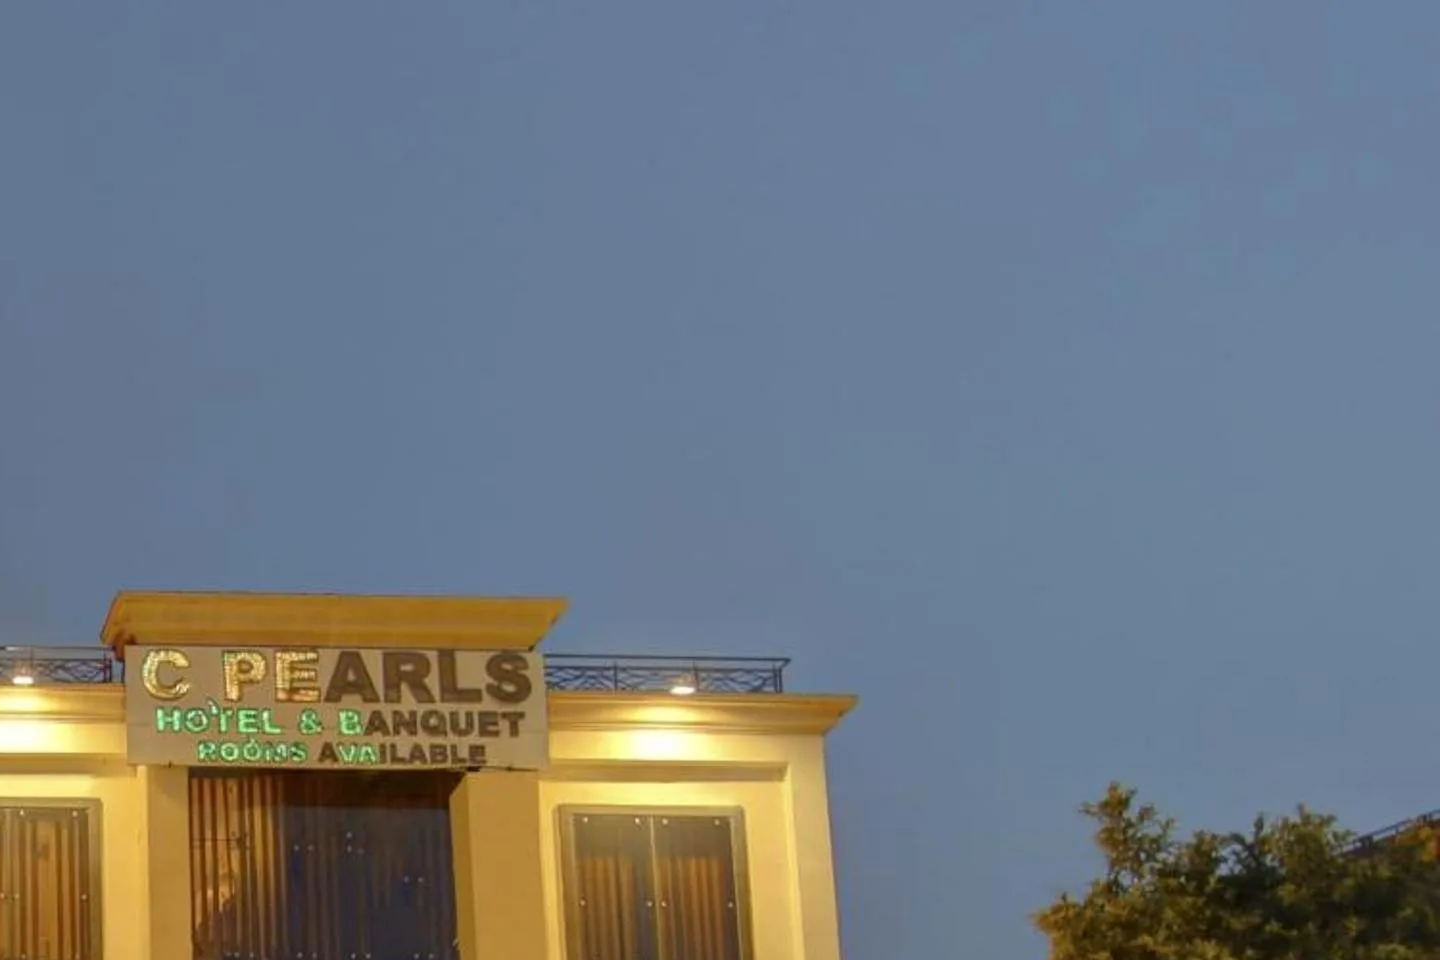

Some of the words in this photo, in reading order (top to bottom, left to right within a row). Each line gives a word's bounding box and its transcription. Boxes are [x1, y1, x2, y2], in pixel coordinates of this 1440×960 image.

[141, 649, 192, 701] C
[222, 649, 533, 704] PEARLS
[156, 708, 281, 735] HOTEL
[298, 709, 323, 735] &
[339, 708, 526, 738] BANQUET
[198, 739, 308, 763] ROOMS
[317, 739, 487, 765] AVAILABLE
